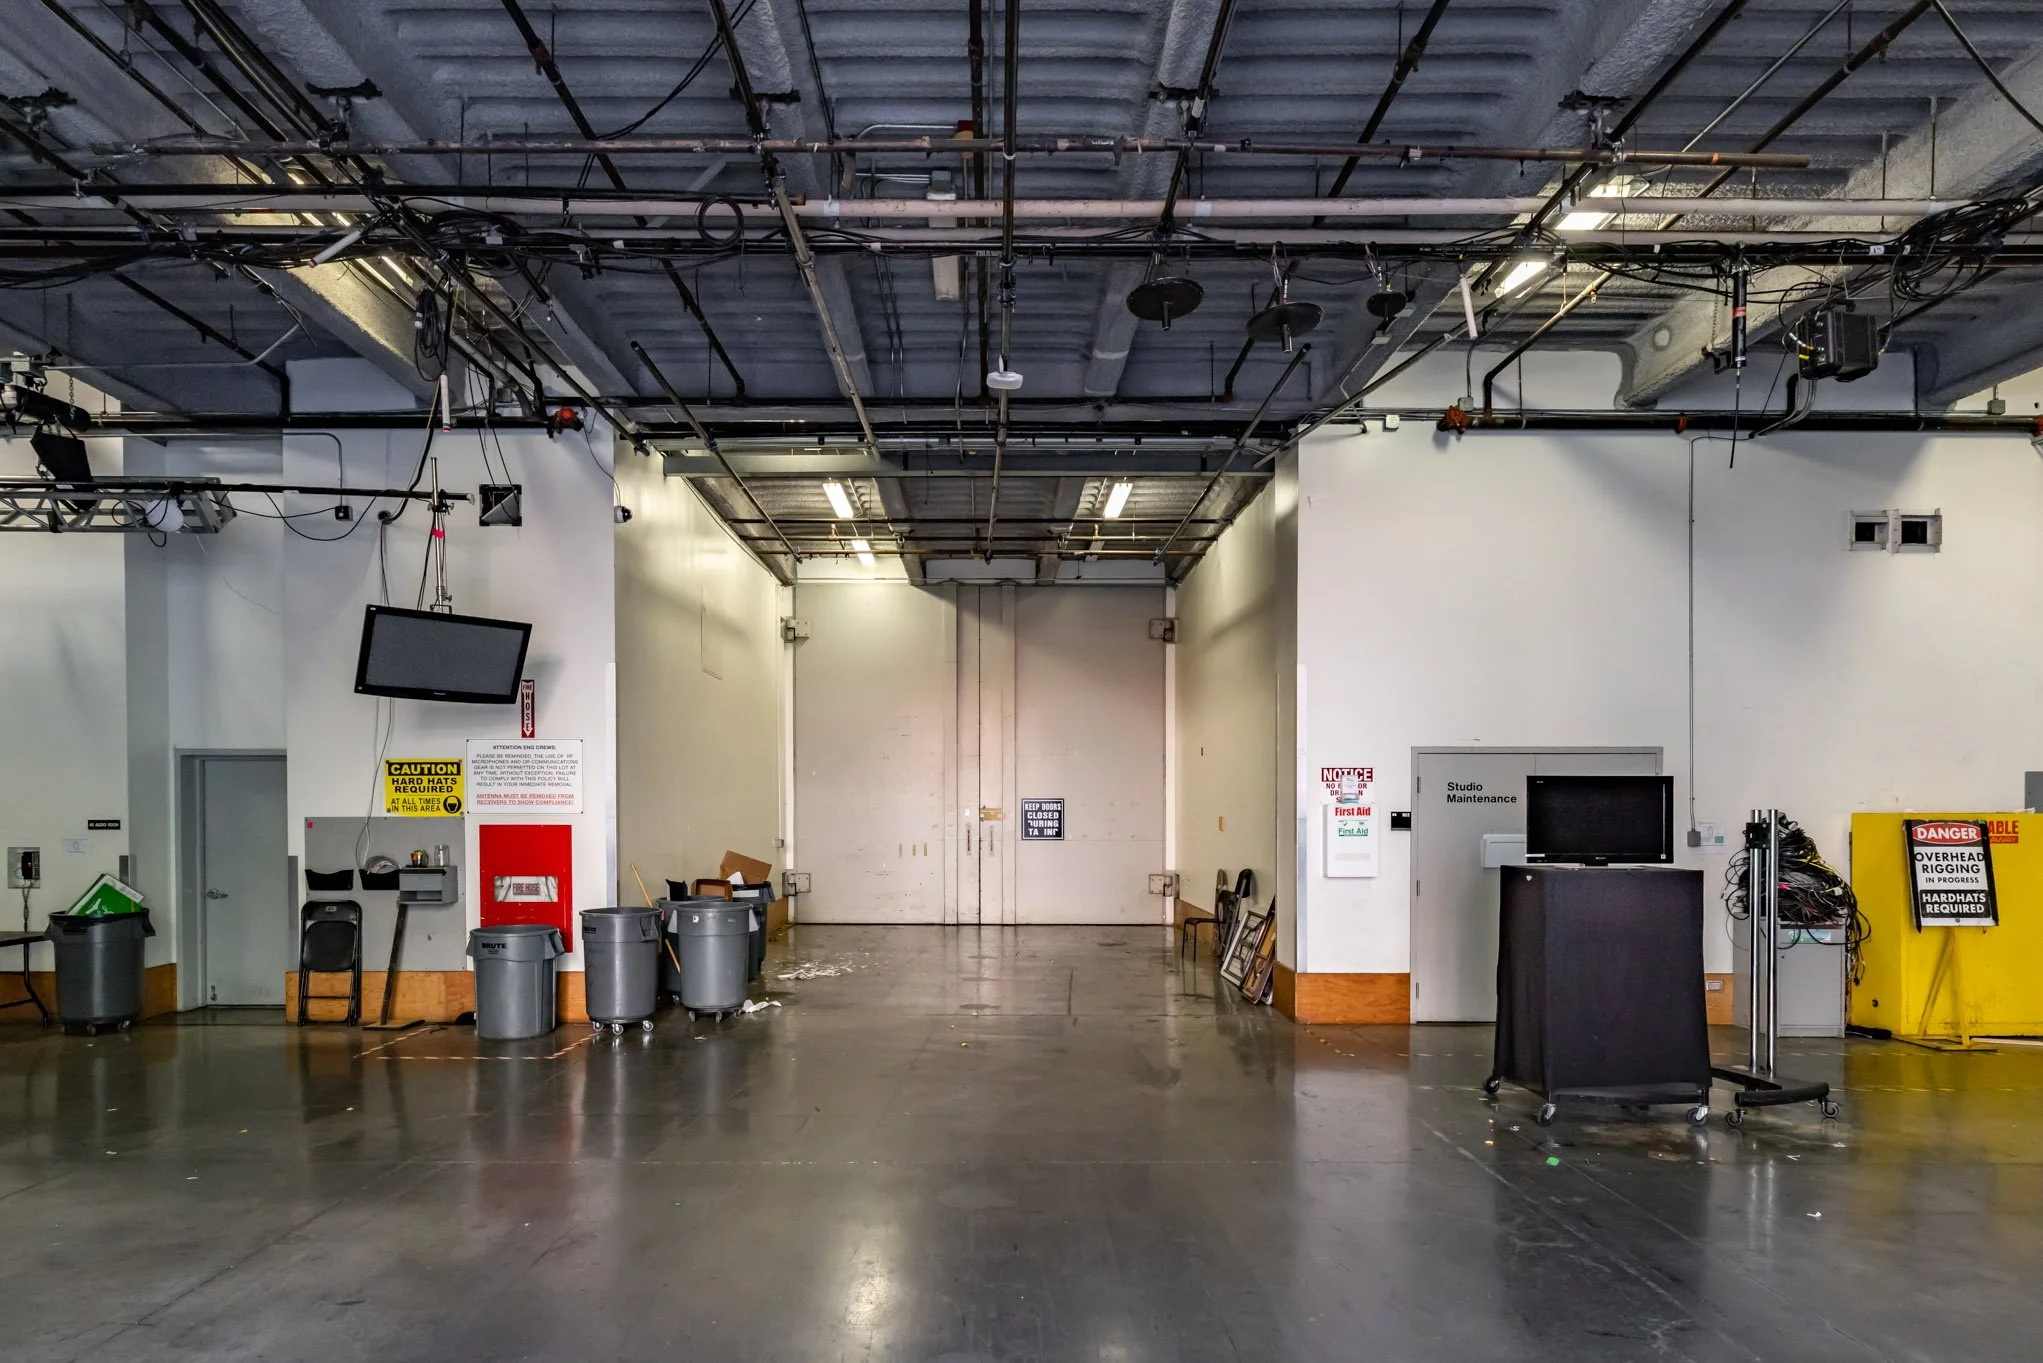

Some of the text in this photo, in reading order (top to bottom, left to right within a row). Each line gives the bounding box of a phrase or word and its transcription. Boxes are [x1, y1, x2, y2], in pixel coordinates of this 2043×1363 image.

[390, 764, 458, 774] CAUTION
[1323, 768, 1372, 781] NOTICE
[1447, 782, 1483, 791] Studio
[1447, 794, 1517, 803] Maintenance
[1335, 807, 1371, 816] First Aid
[1988, 820, 2018, 834] ABLE
[1917, 828, 1977, 839] DANGER
[1915, 852, 1985, 862] OVERHEAD
[1922, 864, 1980, 874] RIGGING
[1922, 893, 1986, 902] HARDHATS
[1926, 904, 1984, 913] REQUIRED
